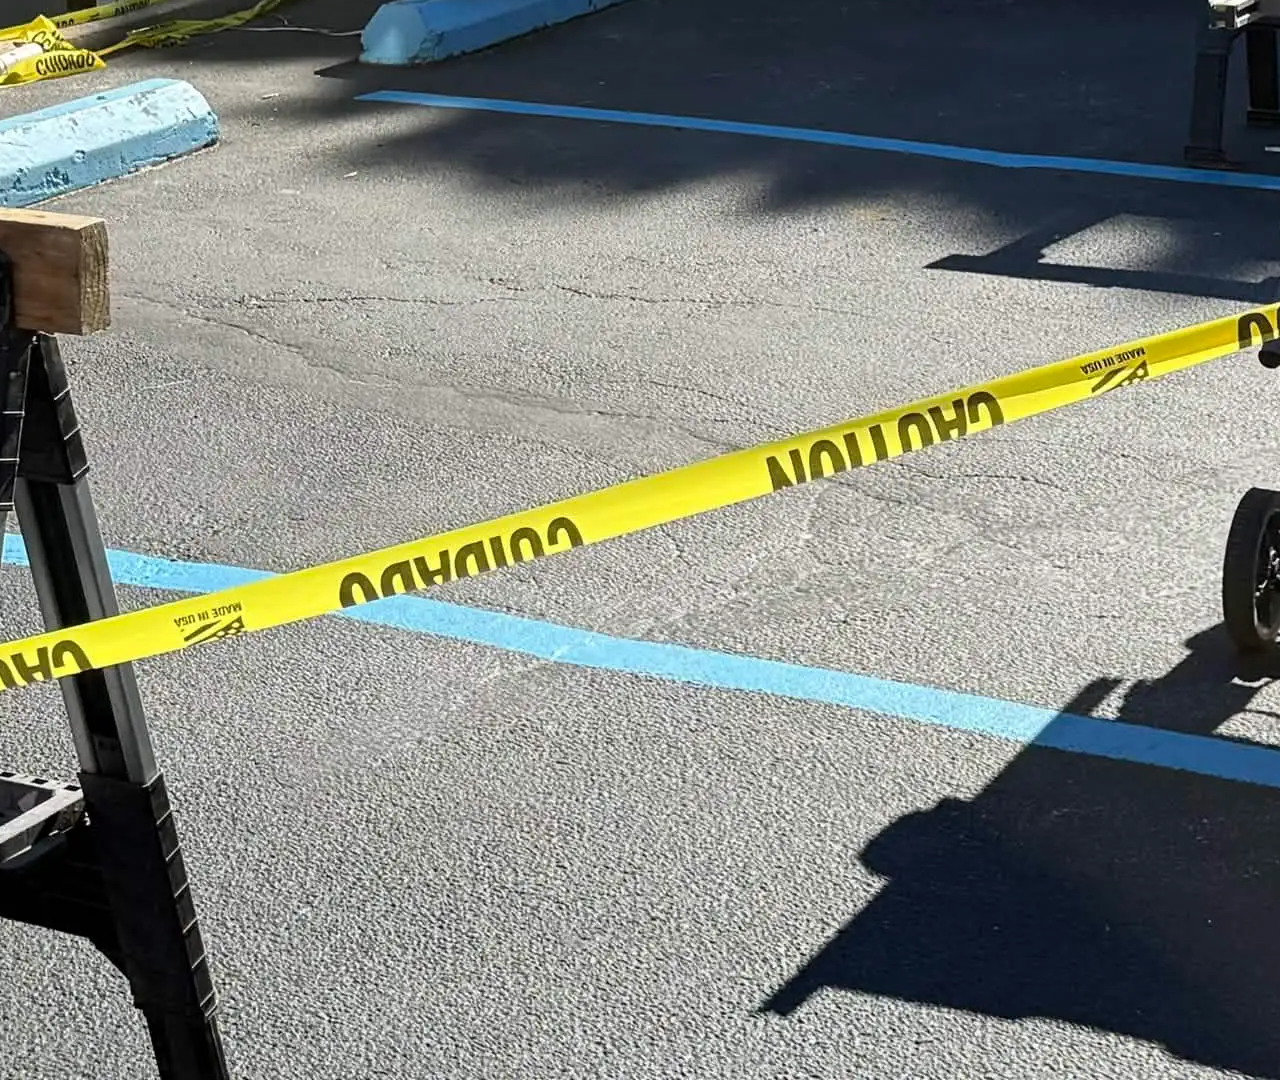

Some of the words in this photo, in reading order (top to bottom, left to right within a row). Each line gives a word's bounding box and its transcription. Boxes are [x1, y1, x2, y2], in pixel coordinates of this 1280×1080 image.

[765, 390, 1004, 491] CAUTION
[211, 601, 242, 618] MADE
[173, 614, 196, 628] USA
